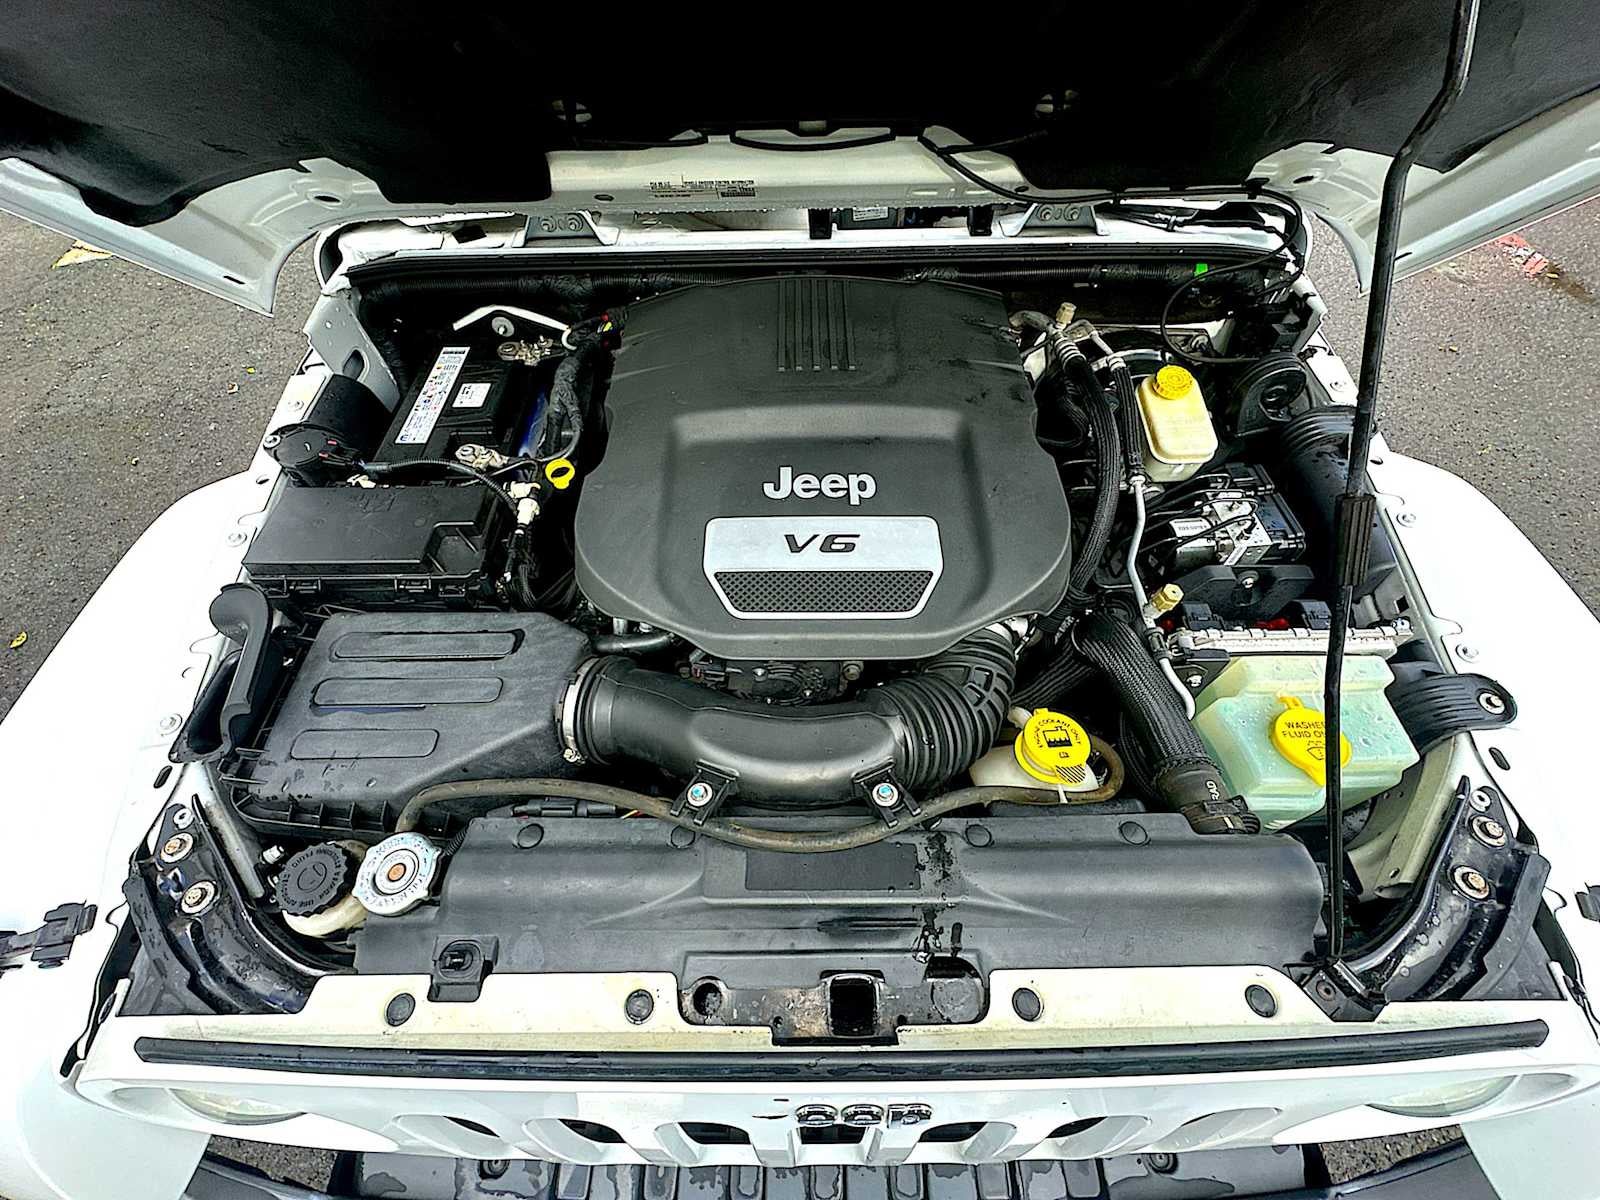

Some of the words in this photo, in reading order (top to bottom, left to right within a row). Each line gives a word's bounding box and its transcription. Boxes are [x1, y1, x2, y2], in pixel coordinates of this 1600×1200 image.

[763, 466, 876, 505] Jeep
[784, 533, 860, 553] V6
[1038, 719, 1070, 728] COOLANT
[1282, 730, 1311, 738] FLUID
